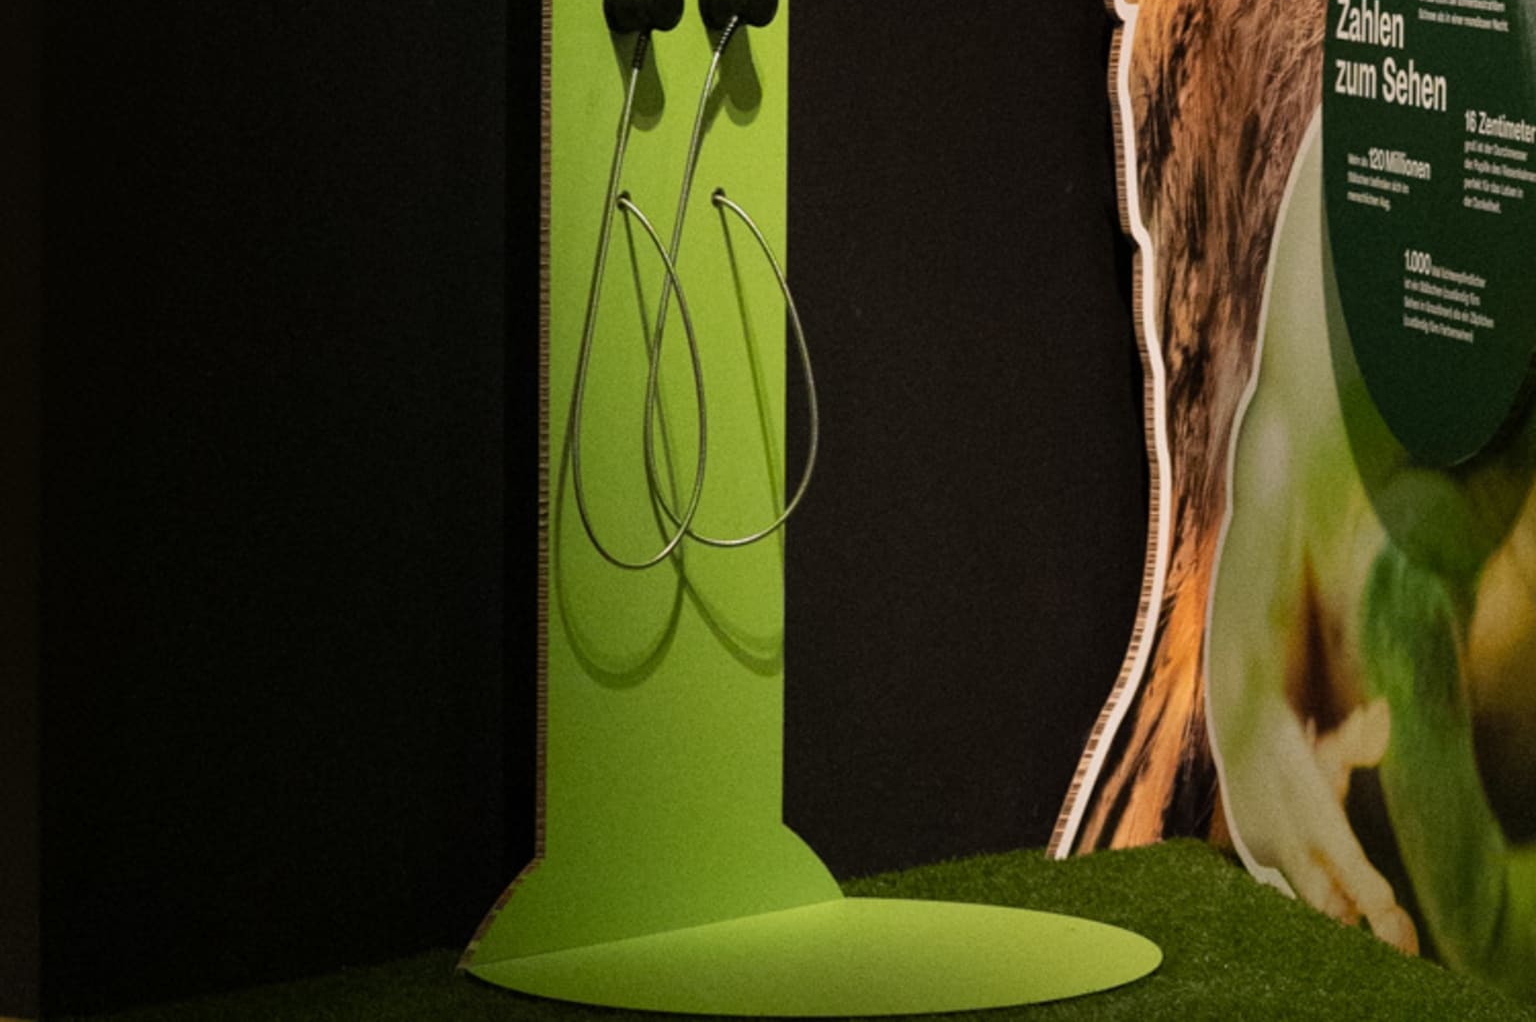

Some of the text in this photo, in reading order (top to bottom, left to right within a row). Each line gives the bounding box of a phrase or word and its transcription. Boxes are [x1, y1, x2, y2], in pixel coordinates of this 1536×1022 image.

[1335, 56, 1447, 113] zum Sehen
[1386, 149, 1431, 181] Millionen
